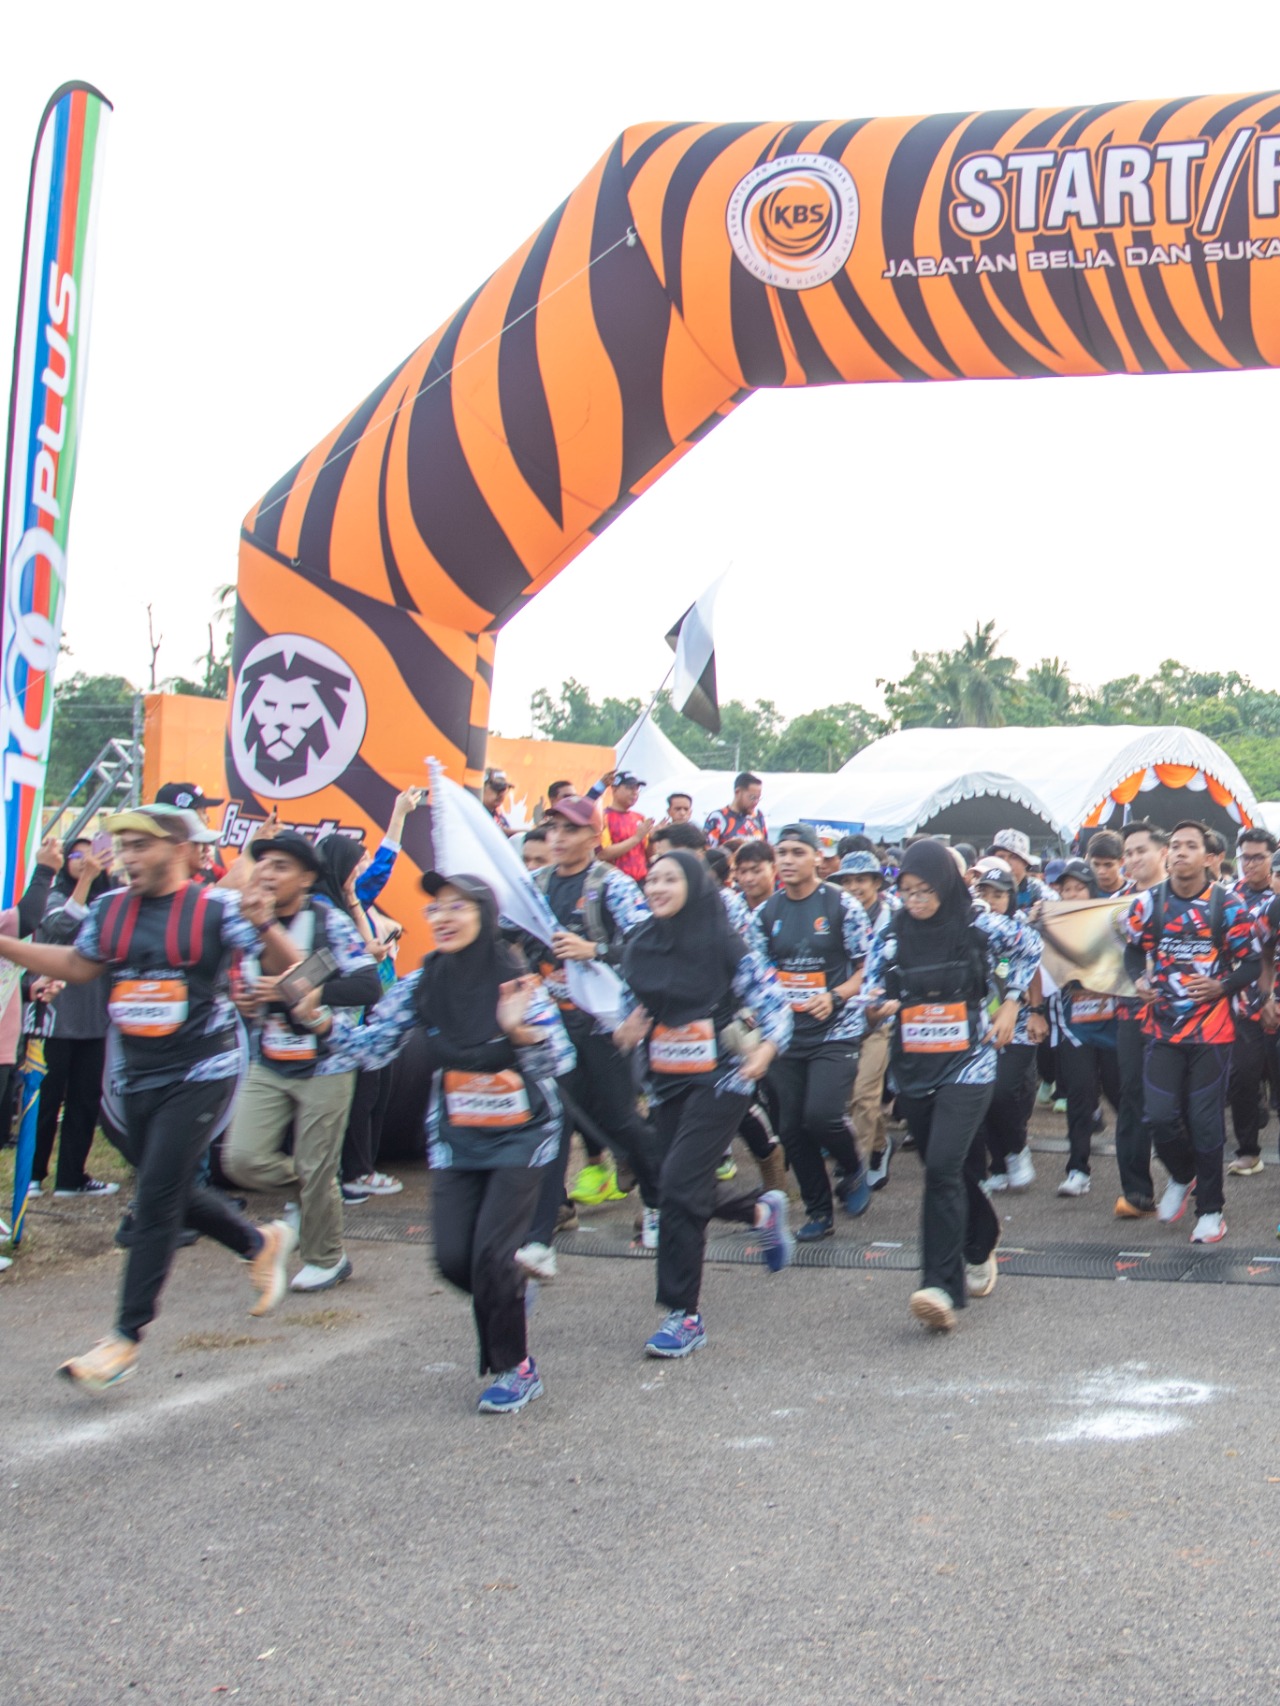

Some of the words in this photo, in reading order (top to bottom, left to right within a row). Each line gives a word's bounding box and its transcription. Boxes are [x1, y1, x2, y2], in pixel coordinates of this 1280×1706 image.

[774, 203, 825, 230] KBS
[882, 252, 1017, 279] JABATAN
[1027, 247, 1117, 272] BELIA
[1126, 243, 1192, 268] DAN
[32, 261, 78, 521] PLUS
